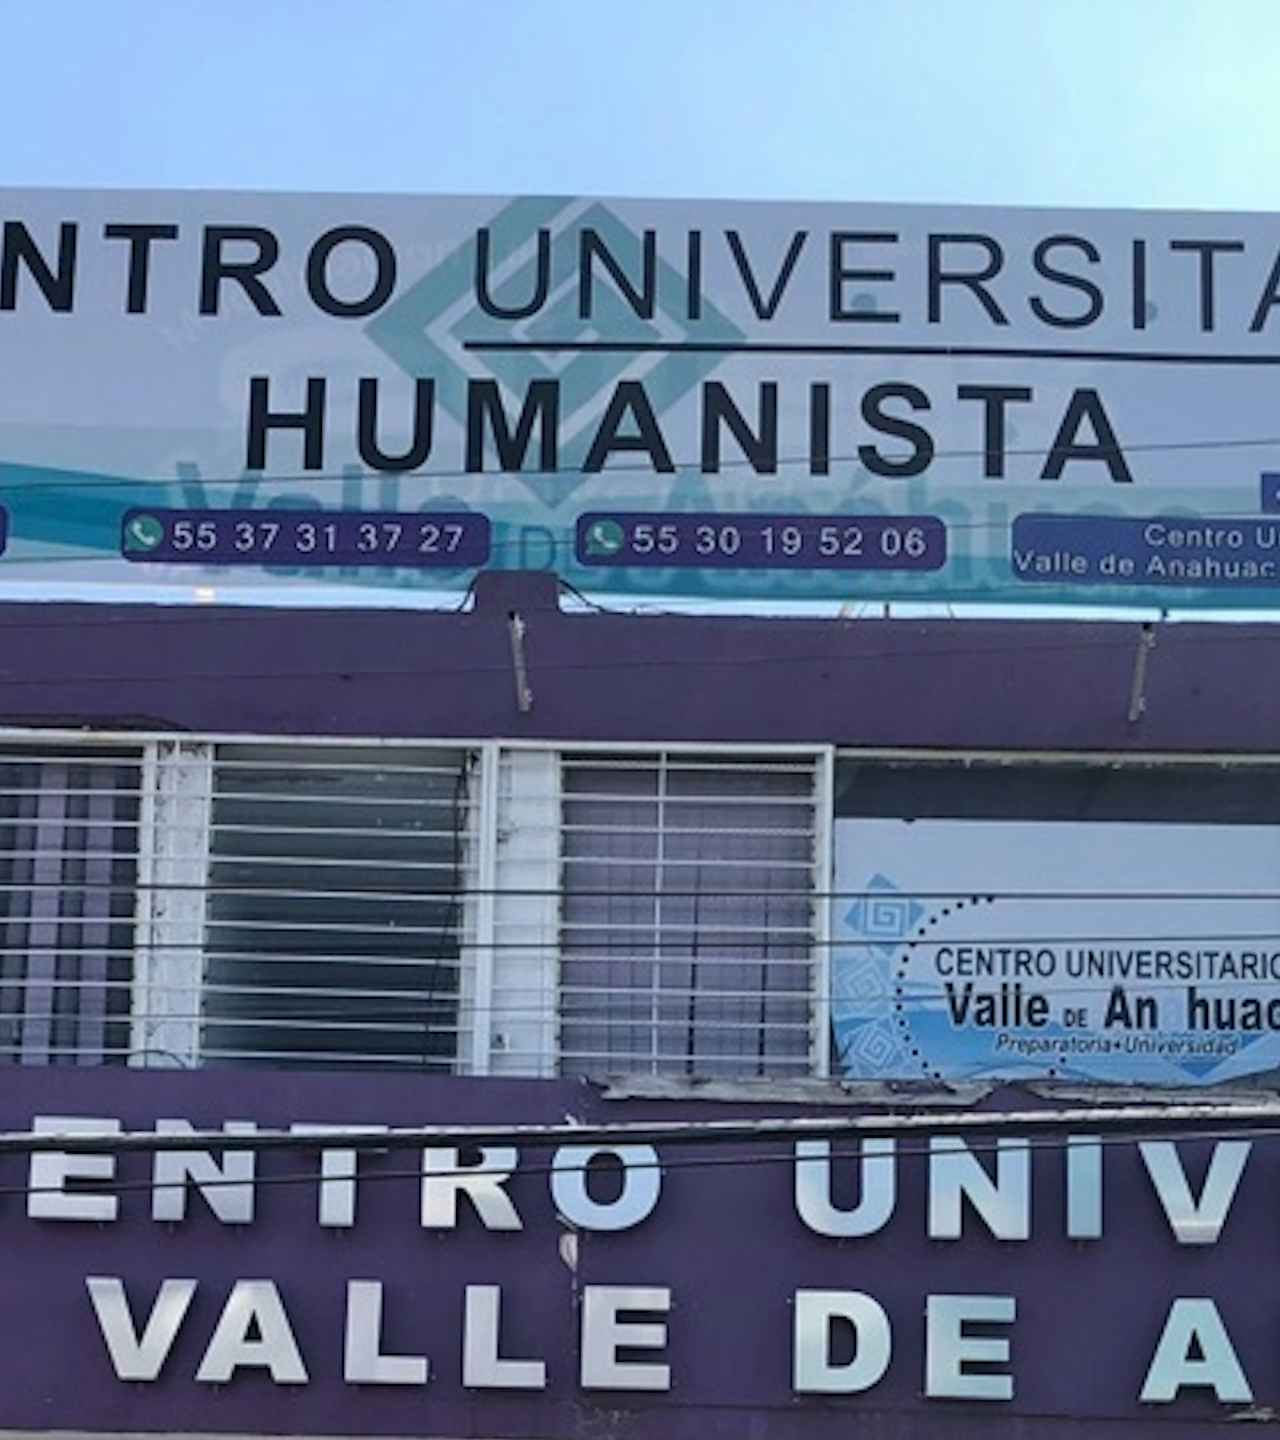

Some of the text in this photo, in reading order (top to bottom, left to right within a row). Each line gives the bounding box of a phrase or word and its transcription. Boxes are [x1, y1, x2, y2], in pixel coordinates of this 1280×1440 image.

[245, 376, 1133, 484] HUMANISTA
[171, 524, 464, 552] 55 37 31 37 27
[634, 525, 926, 556] 55 30 19 52 06
[1145, 524, 1243, 549] Centro
[1013, 549, 1088, 575] Valle
[1100, 551, 1135, 576] de
[935, 947, 1057, 978] CENTRO
[943, 982, 1050, 1029] Valle
[1063, 1008, 1089, 1029] DE
[85, 1276, 673, 1391] VALLE
[793, 1287, 1017, 1401] DE
